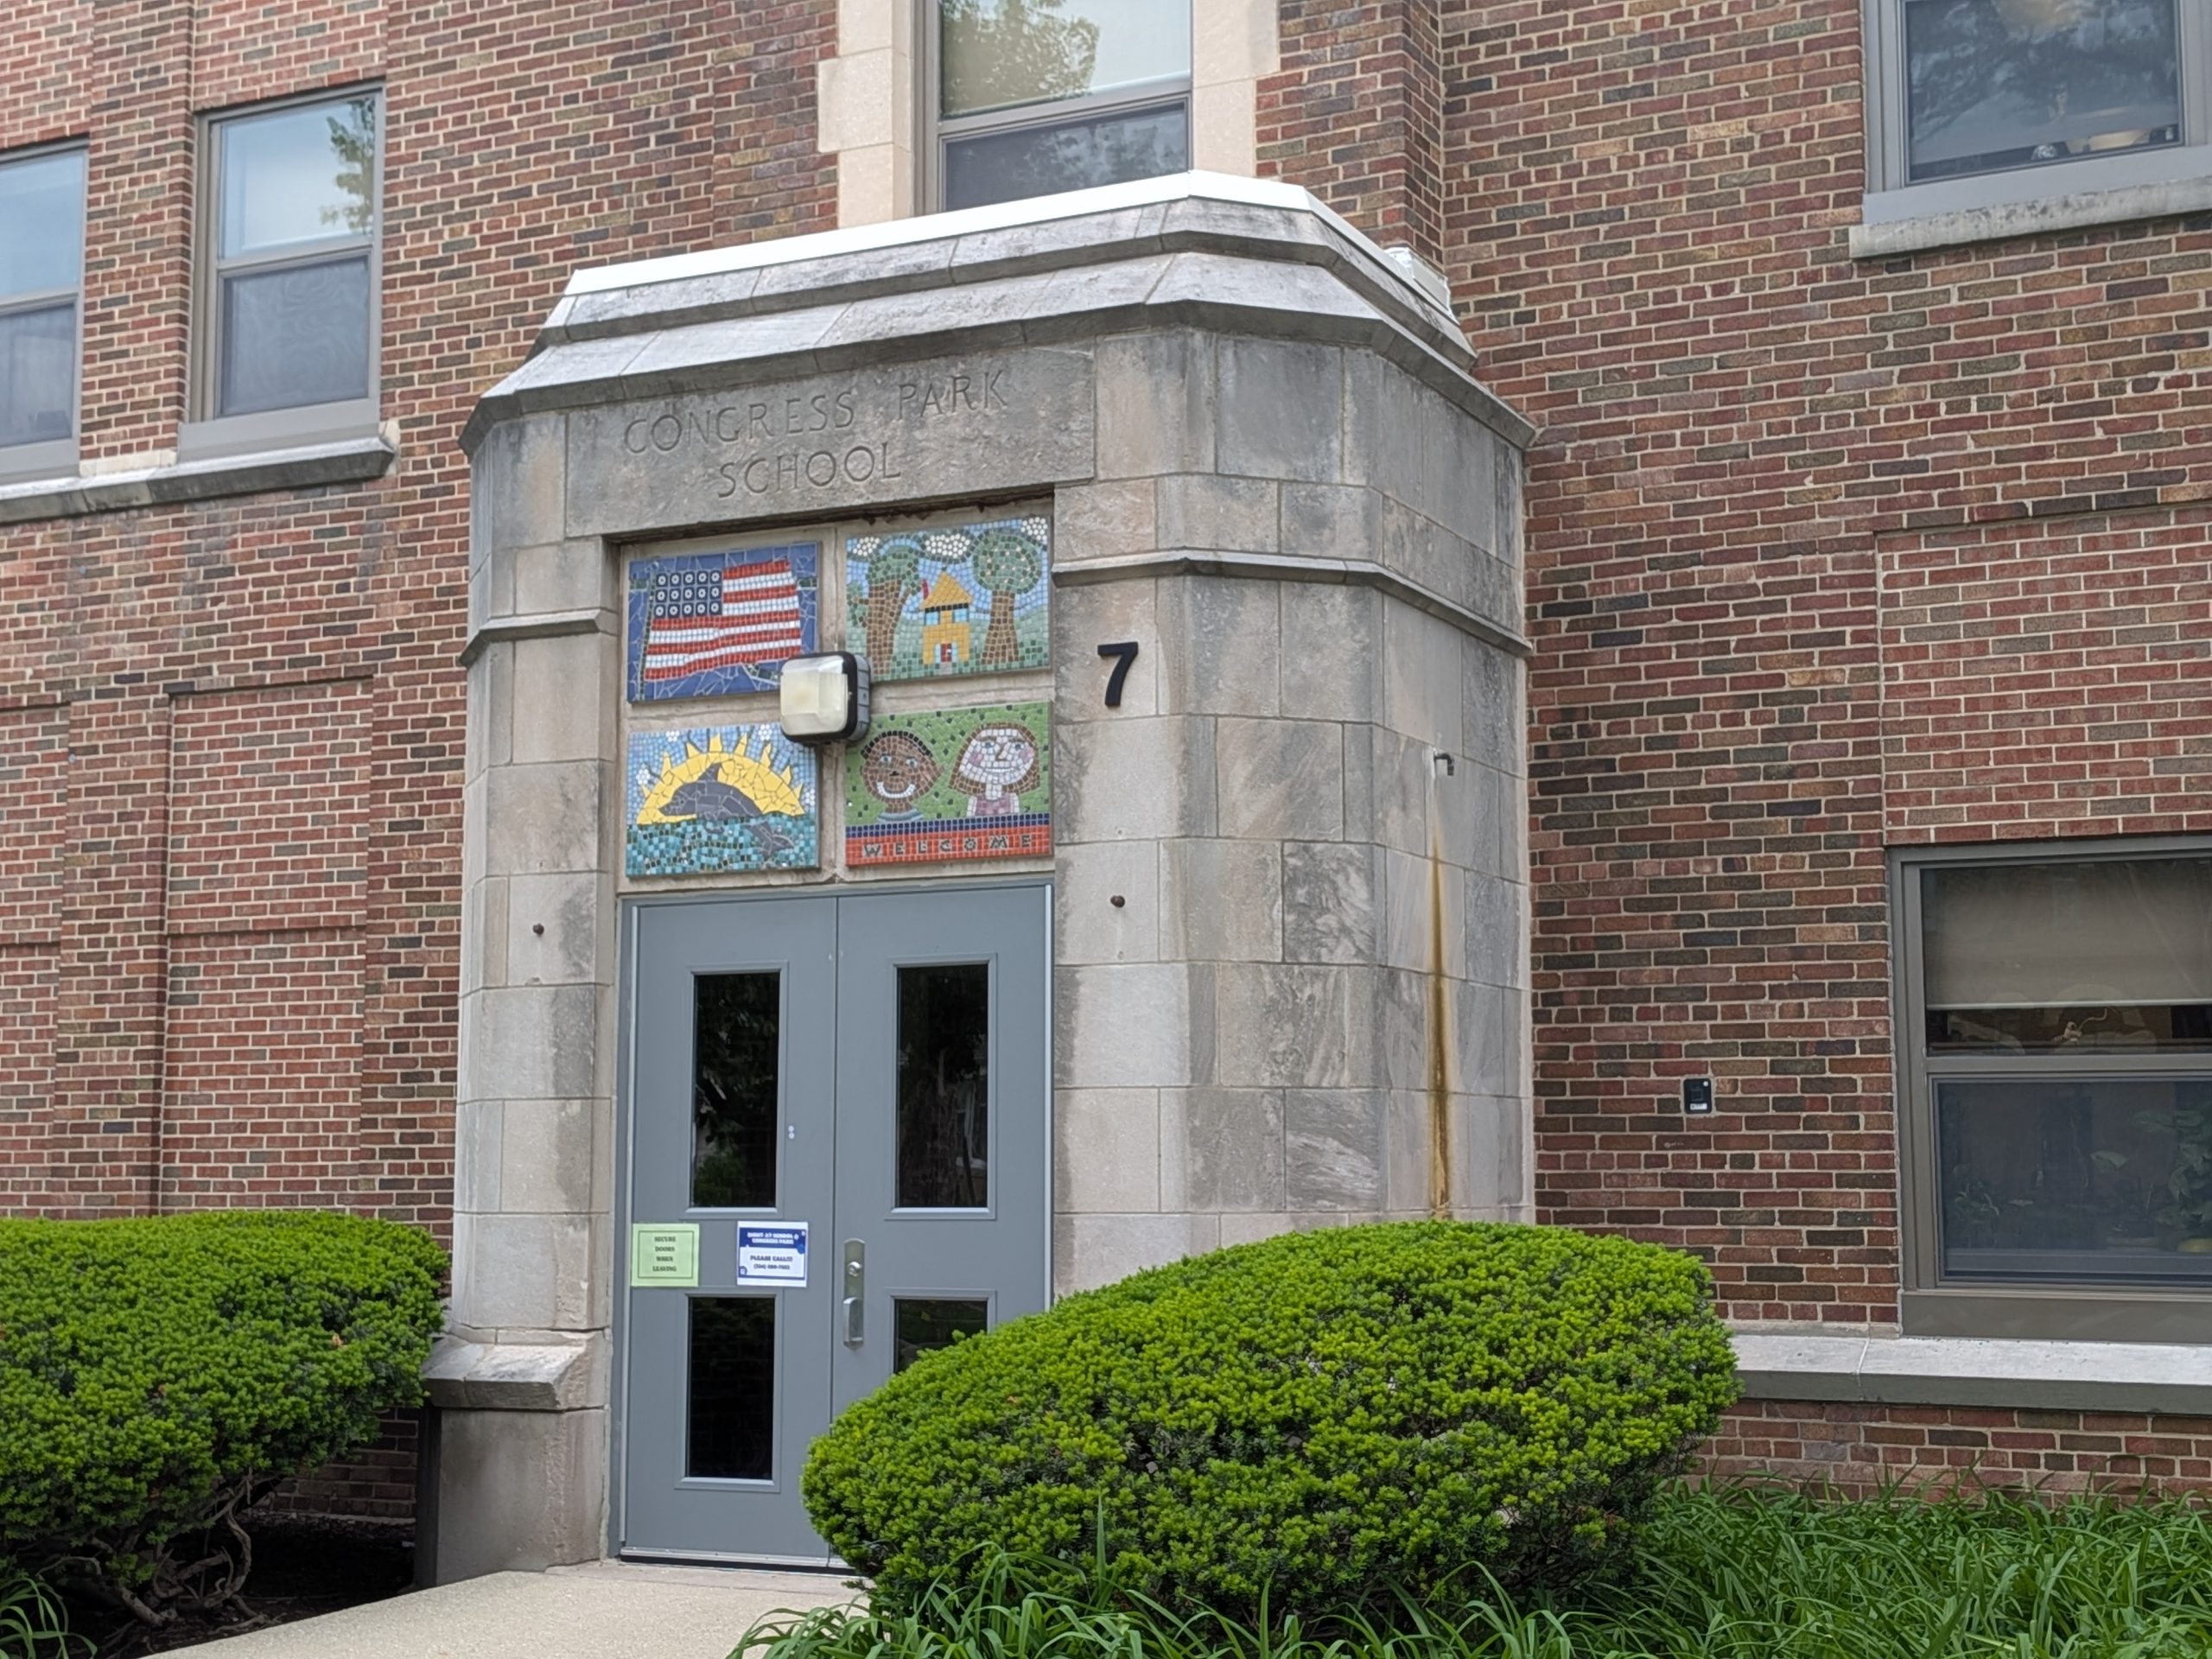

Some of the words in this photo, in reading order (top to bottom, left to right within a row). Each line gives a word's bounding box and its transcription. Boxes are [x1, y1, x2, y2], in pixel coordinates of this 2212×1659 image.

[624, 390, 855, 454] CONGRESS
[897, 370, 1007, 421] PARK
[716, 442, 901, 499] SCHOOL
[1097, 641, 1139, 708] 7
[863, 835, 1032, 857] WELCOME
